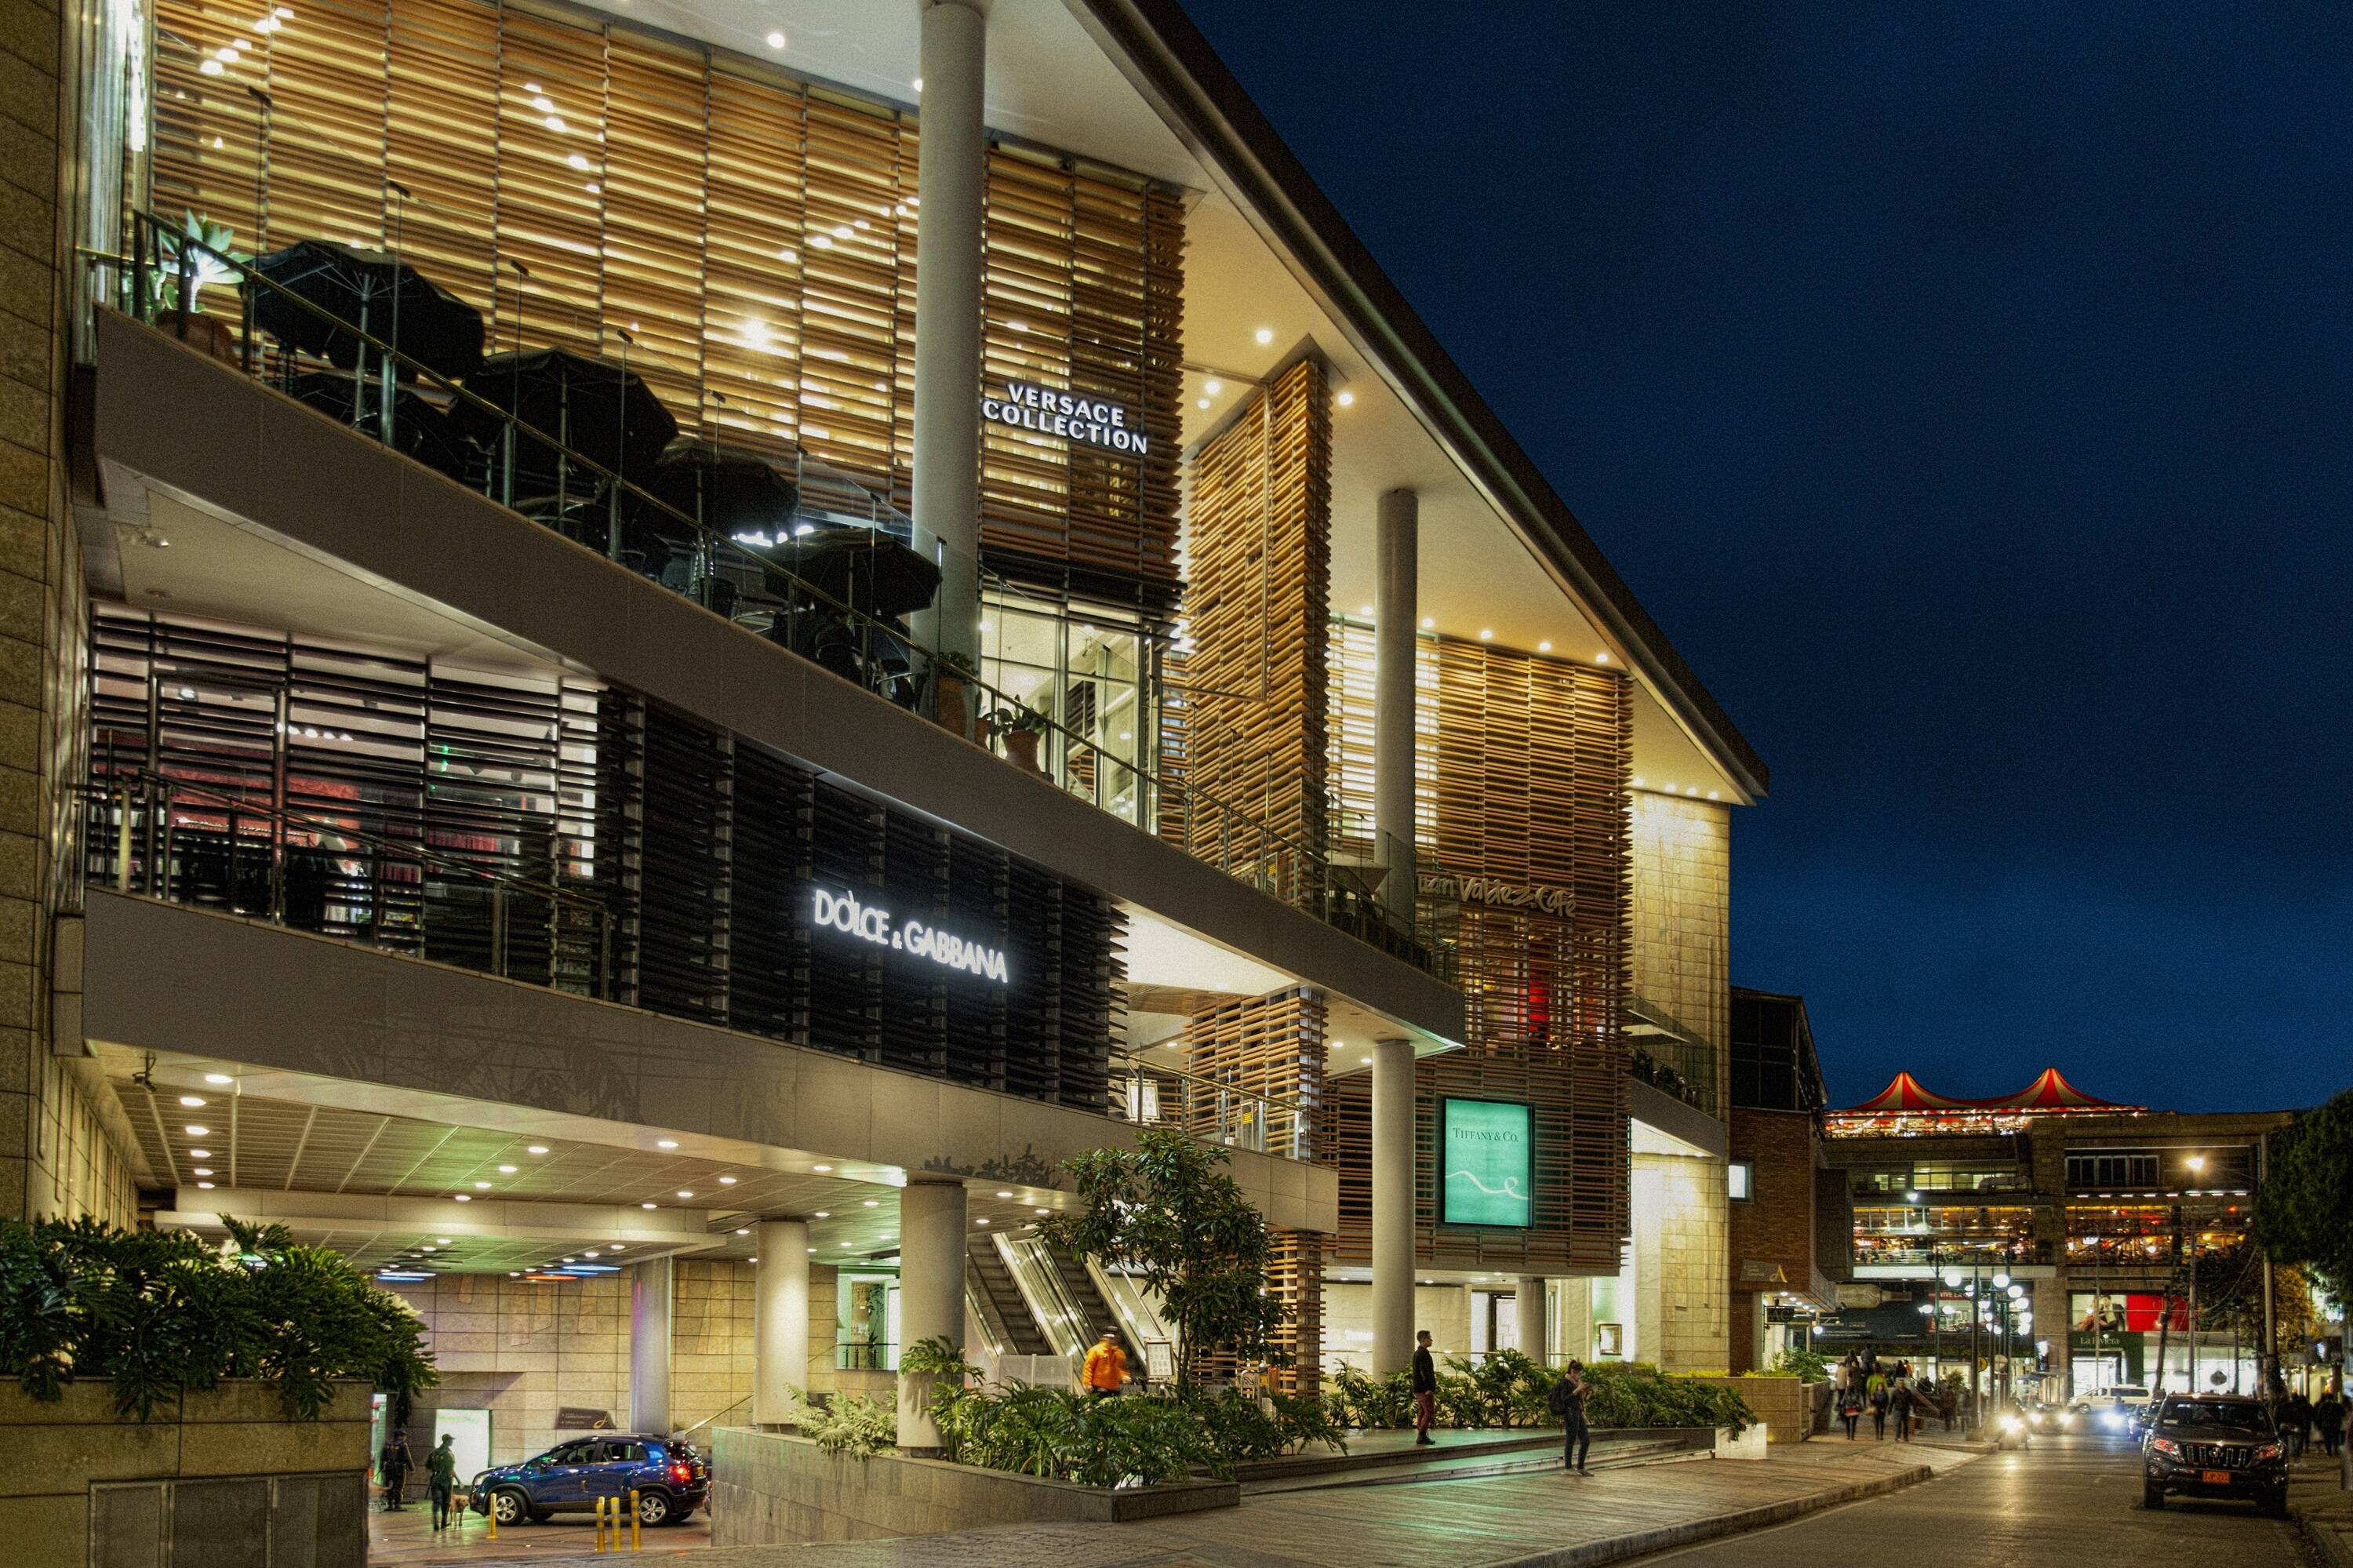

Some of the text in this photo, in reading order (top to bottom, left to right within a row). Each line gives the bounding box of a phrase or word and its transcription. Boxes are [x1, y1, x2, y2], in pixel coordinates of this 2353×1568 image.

[983, 400, 1147, 454] COLLECTION
[1007, 384, 1125, 427] VERSACE
[1417, 873, 1455, 898] uan
[814, 890, 1008, 983] DOLCE & GABBANA
[2092, 1336, 2120, 1345] Rviera
